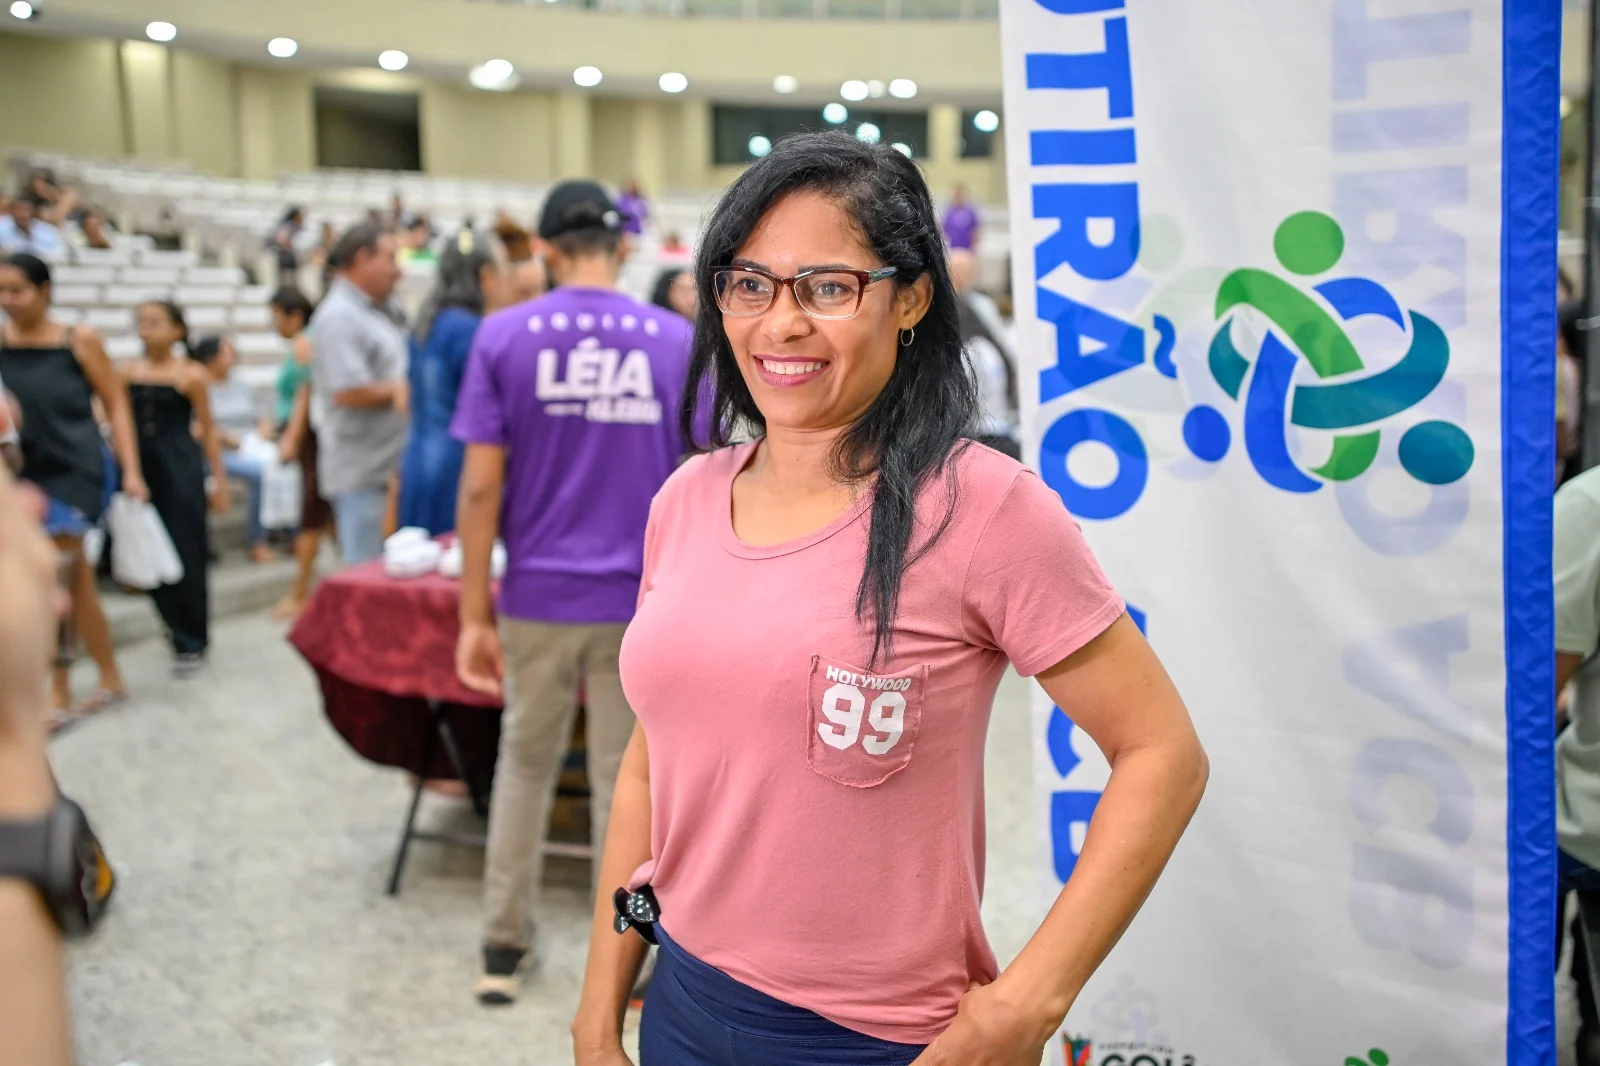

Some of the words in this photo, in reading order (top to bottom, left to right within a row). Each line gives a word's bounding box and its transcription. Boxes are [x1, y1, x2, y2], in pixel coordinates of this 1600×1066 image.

[535, 336, 654, 401] LÉIA
[825, 664, 912, 692] HOLYWOOD
[817, 682, 907, 755] 99
